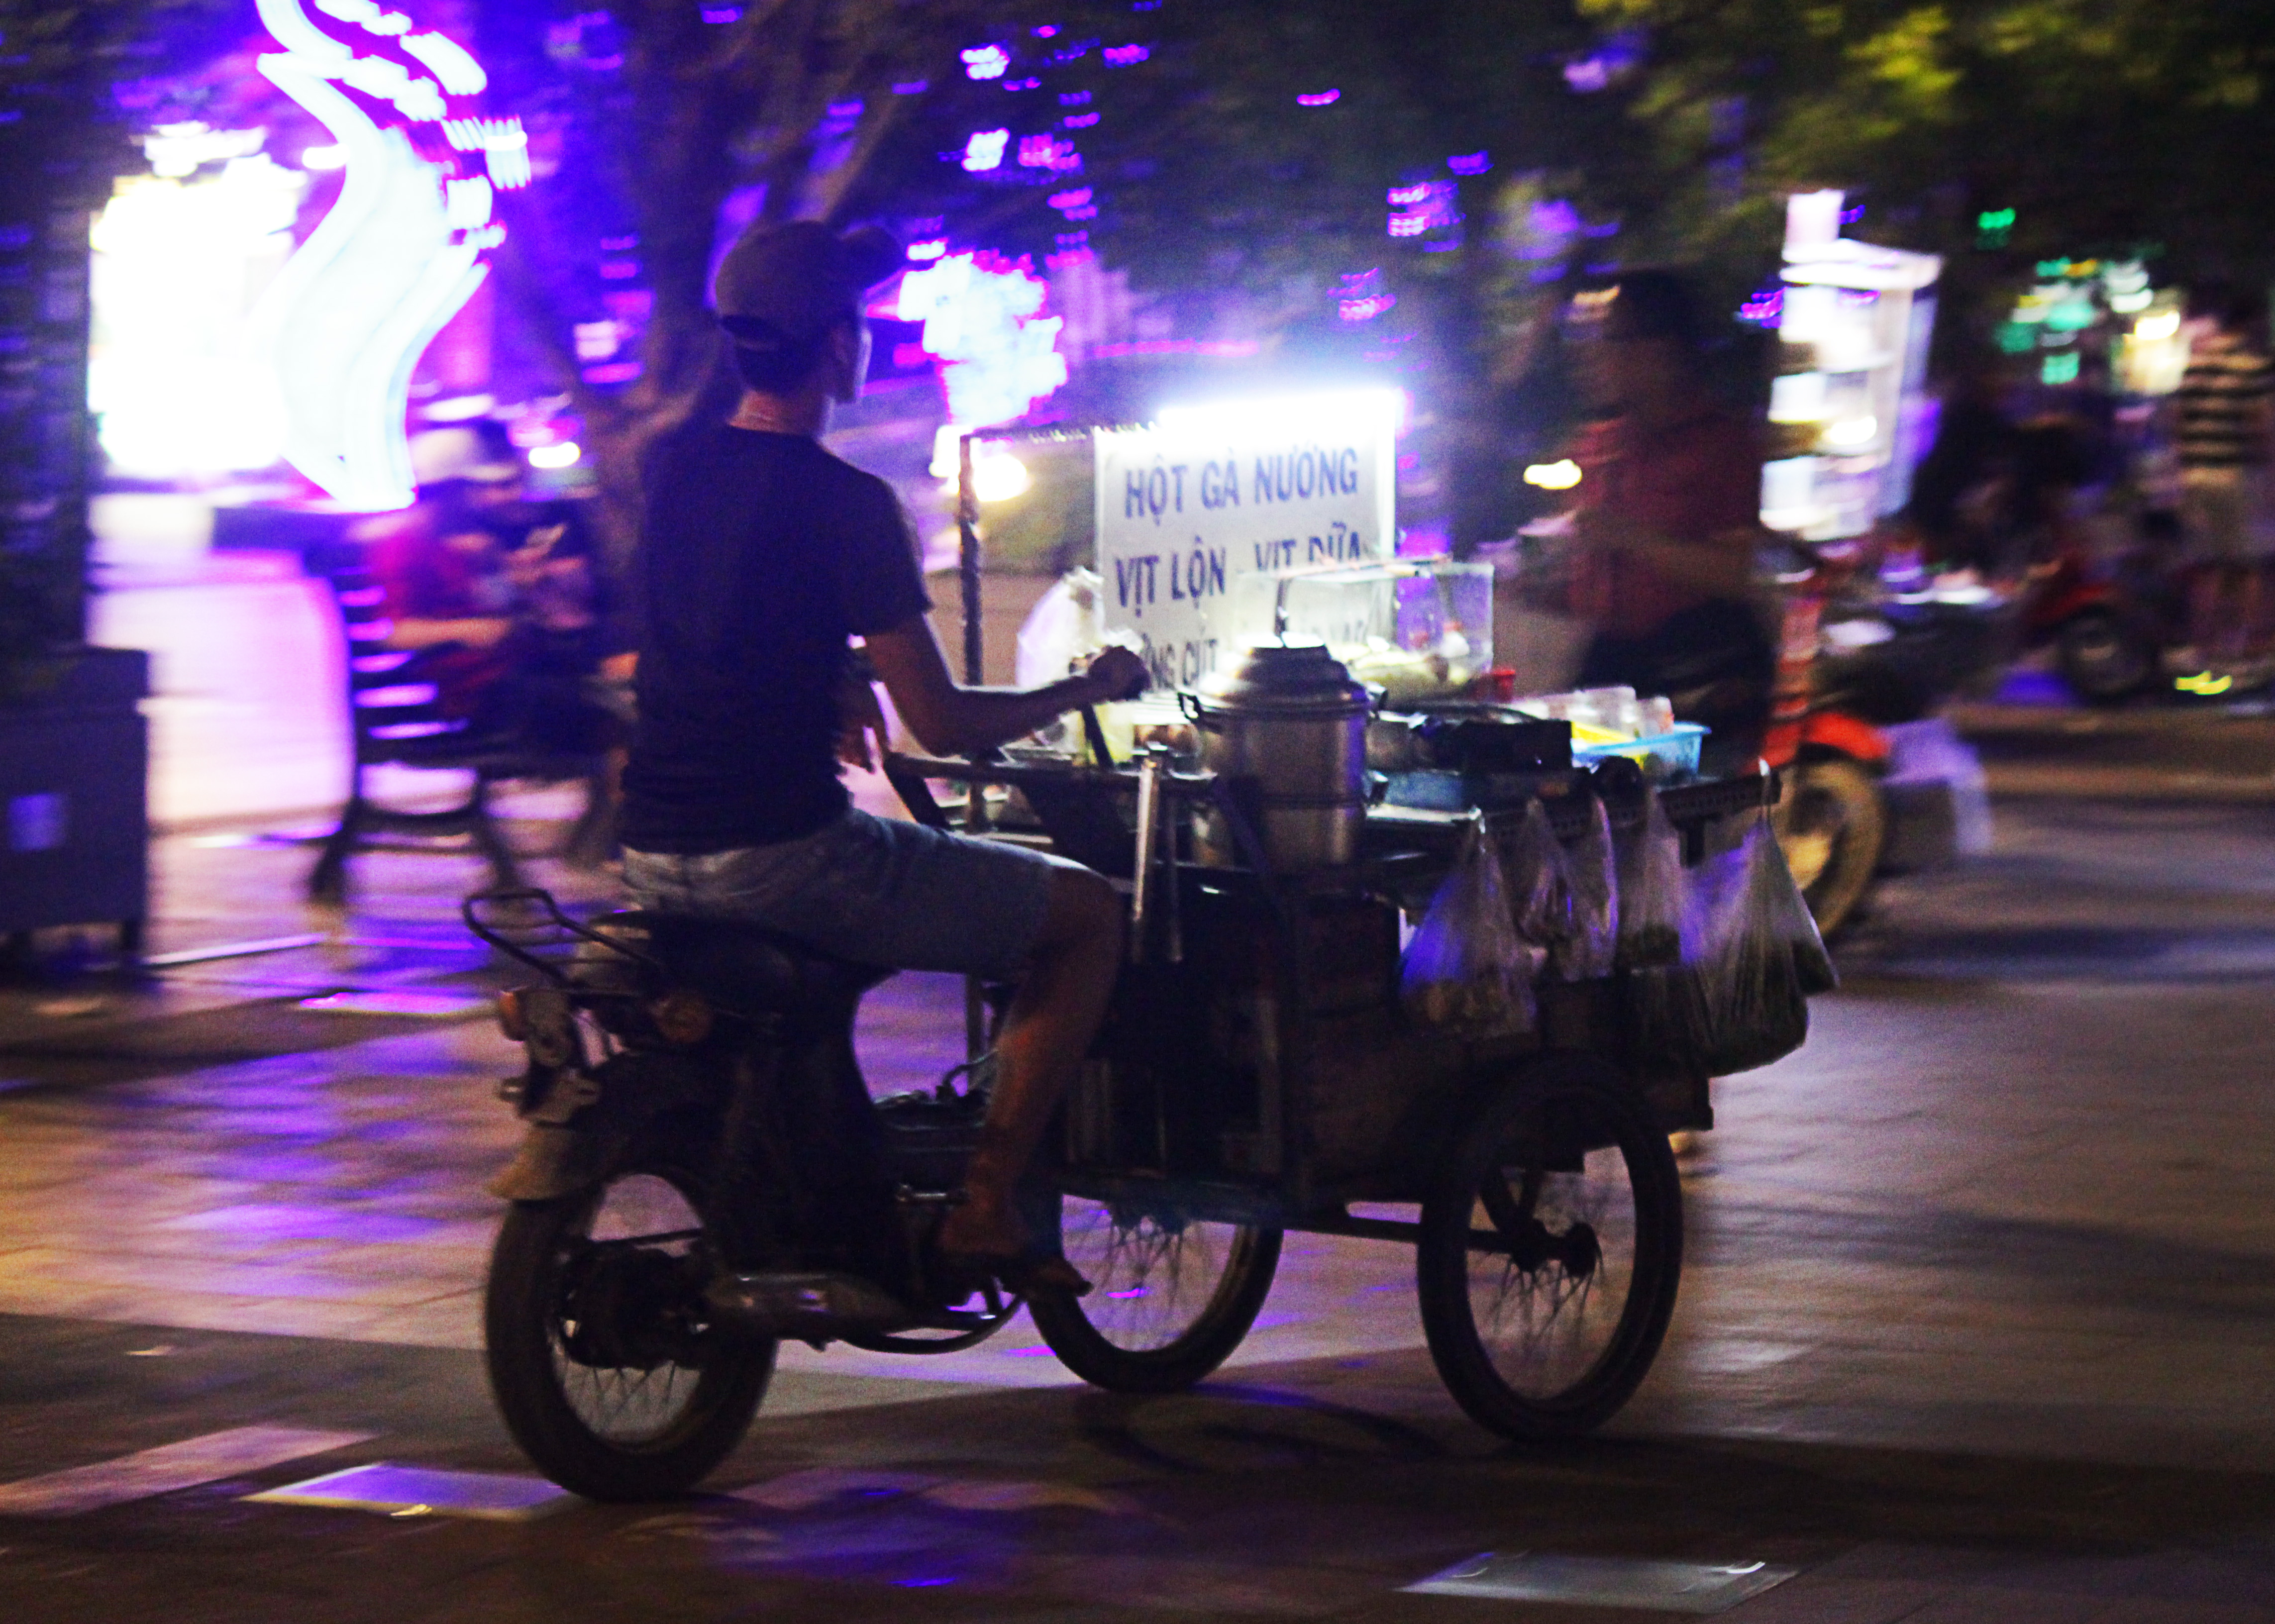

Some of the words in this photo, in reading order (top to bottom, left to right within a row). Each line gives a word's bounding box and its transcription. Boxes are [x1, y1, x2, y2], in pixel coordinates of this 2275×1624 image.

[1125, 452, 1188, 526] HỘT
[1201, 446, 1241, 510] GÀ
[1115, 554, 1160, 618] VỊT
[1171, 534, 1226, 609] LỘN
